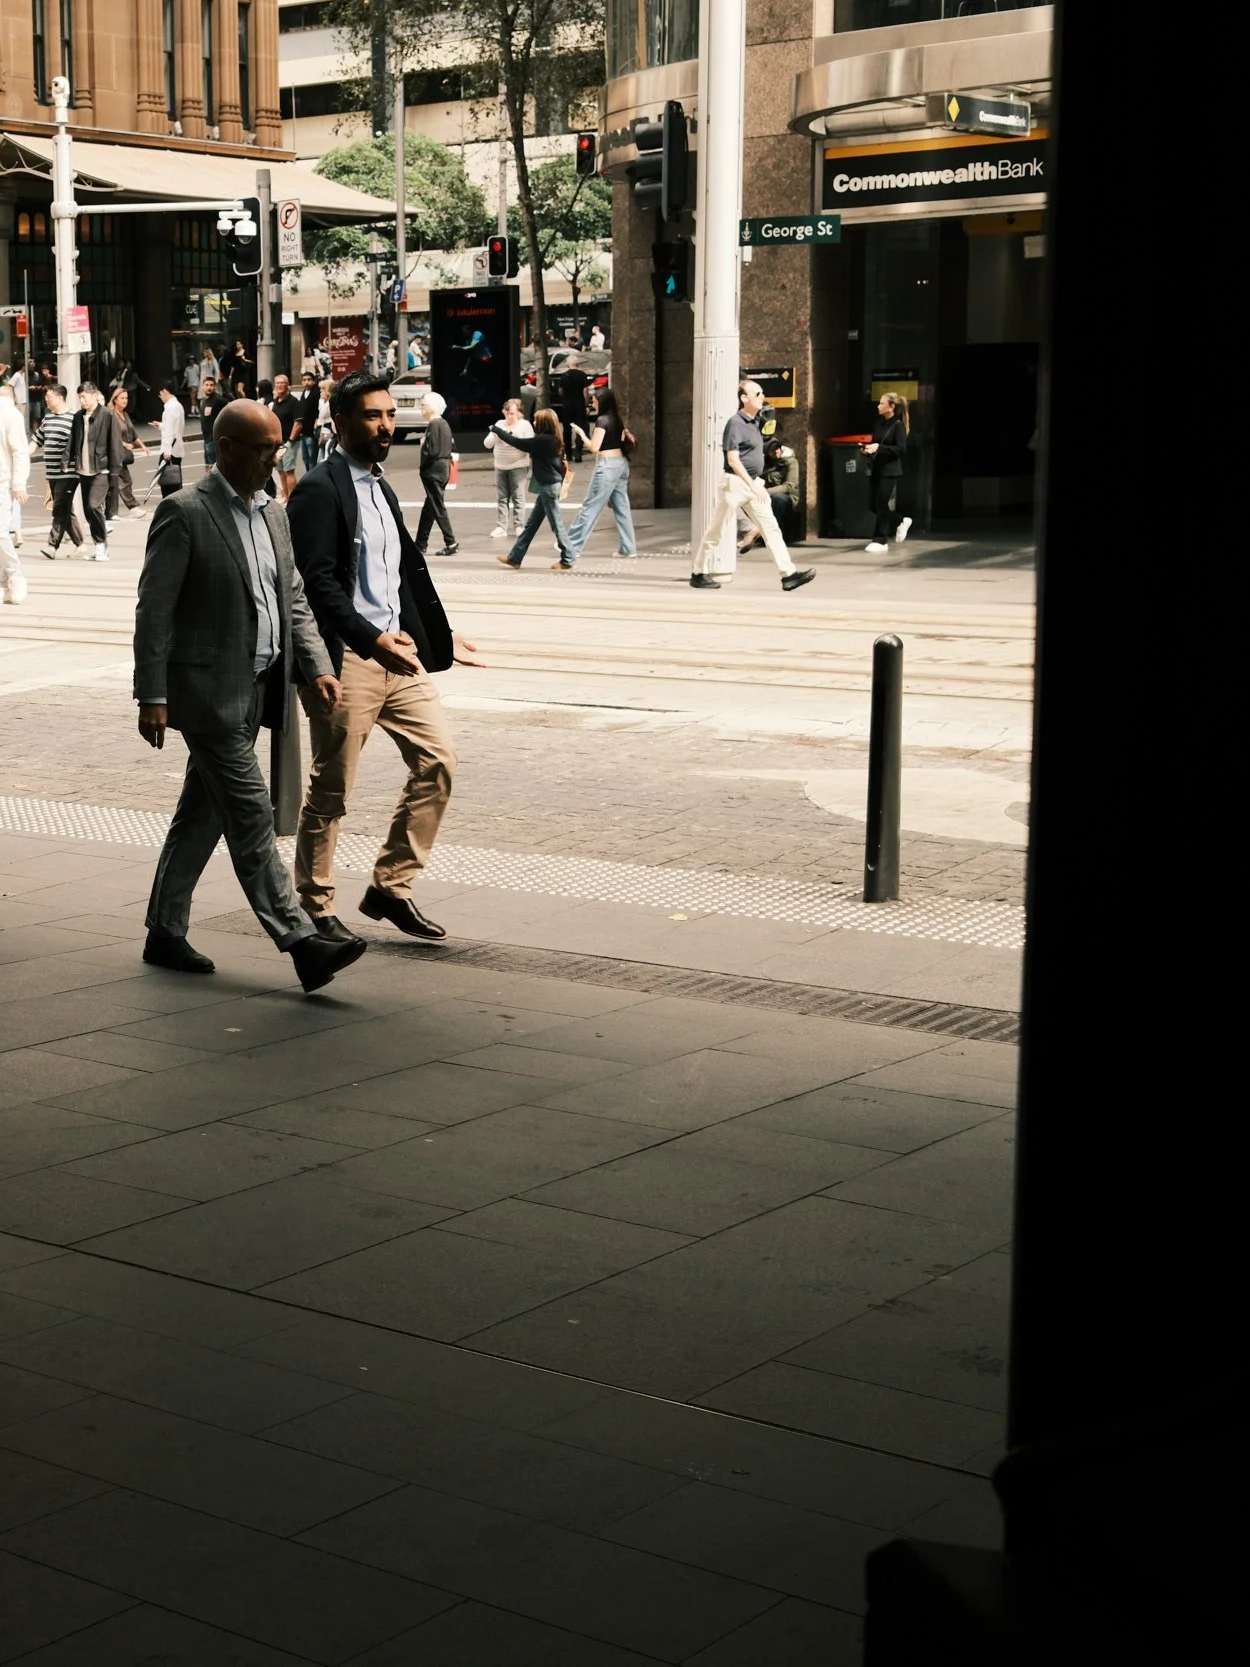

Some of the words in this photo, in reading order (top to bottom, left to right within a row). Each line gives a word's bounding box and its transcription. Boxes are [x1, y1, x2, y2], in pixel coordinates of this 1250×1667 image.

[833, 157, 1044, 193] CommonwealthBank
[761, 223, 814, 241] George
[817, 221, 833, 236] St
[283, 232, 296, 242] NO
[281, 244, 298, 252] RIGHT
[394, 284, 401, 293] P
